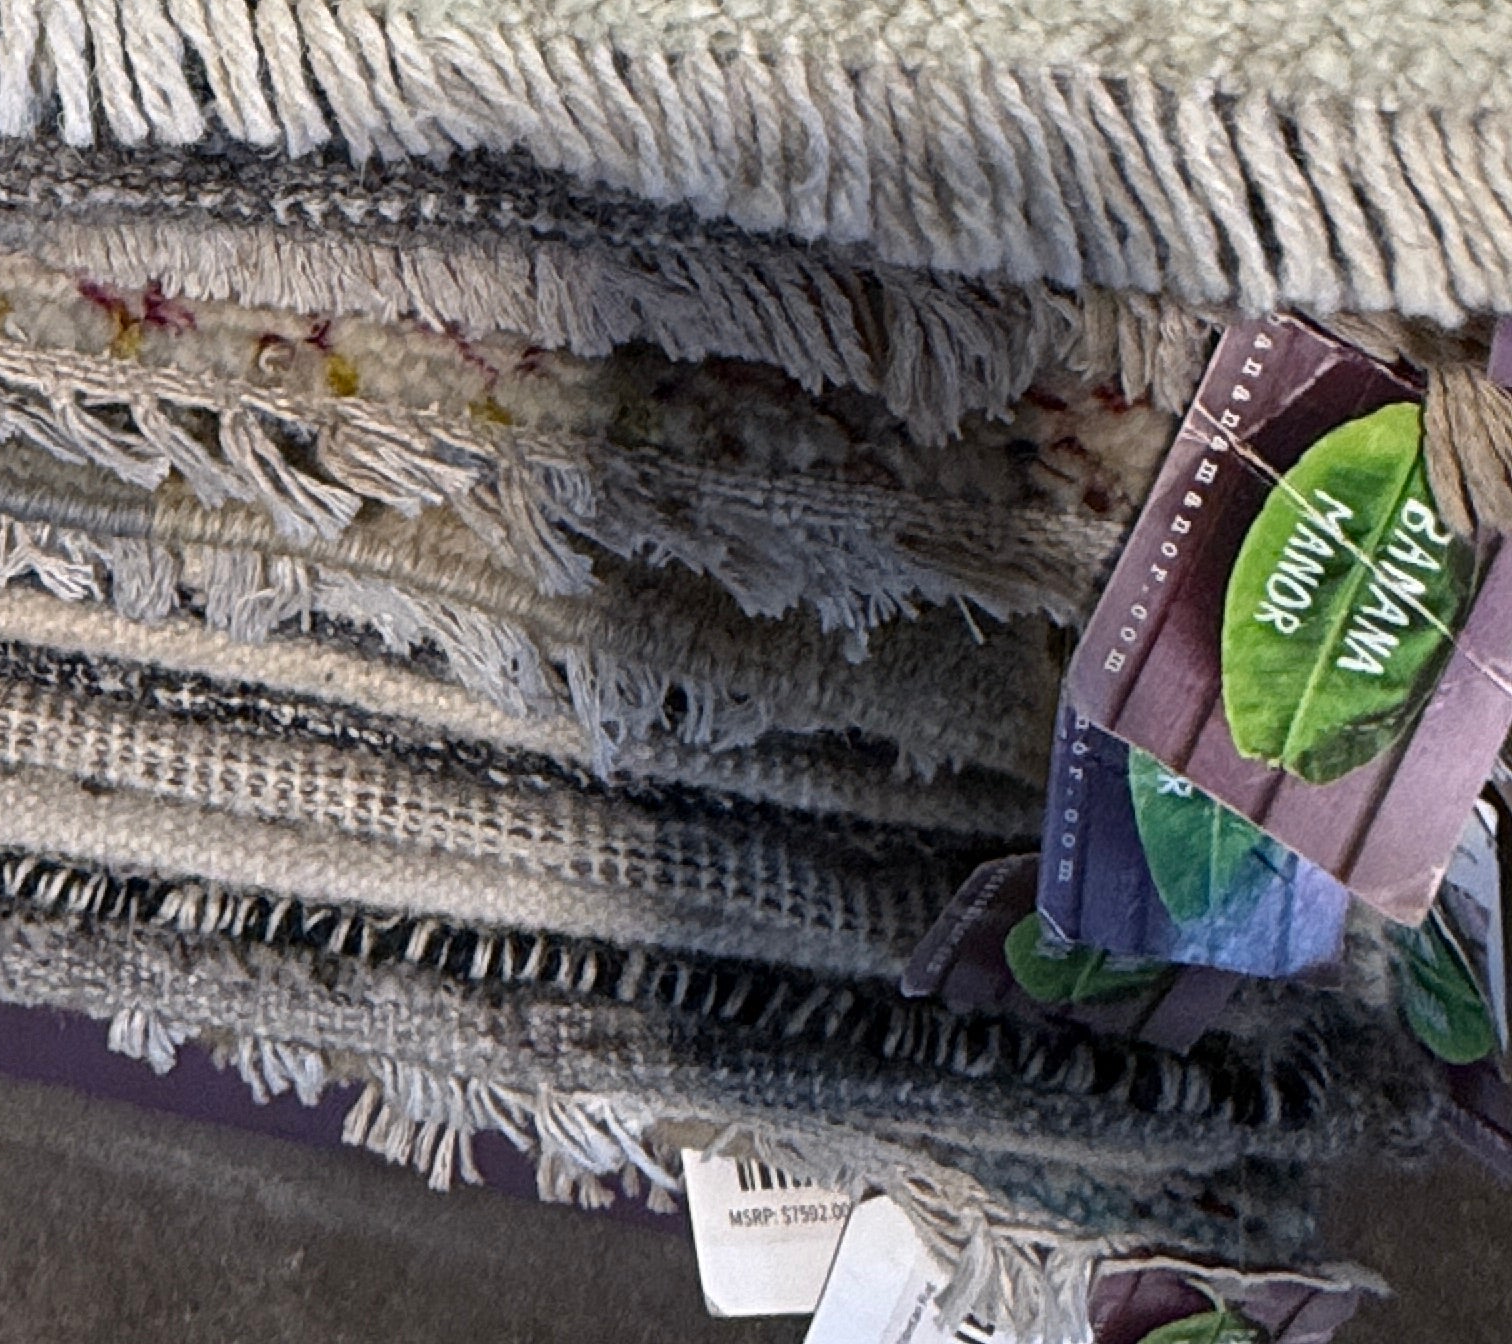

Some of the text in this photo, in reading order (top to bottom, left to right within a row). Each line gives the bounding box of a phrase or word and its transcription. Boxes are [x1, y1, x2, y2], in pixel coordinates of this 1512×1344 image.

[1254, 487, 1355, 635] MANOR
[1336, 497, 1456, 676] BANANA
[728, 1207, 778, 1228] MSRP:
